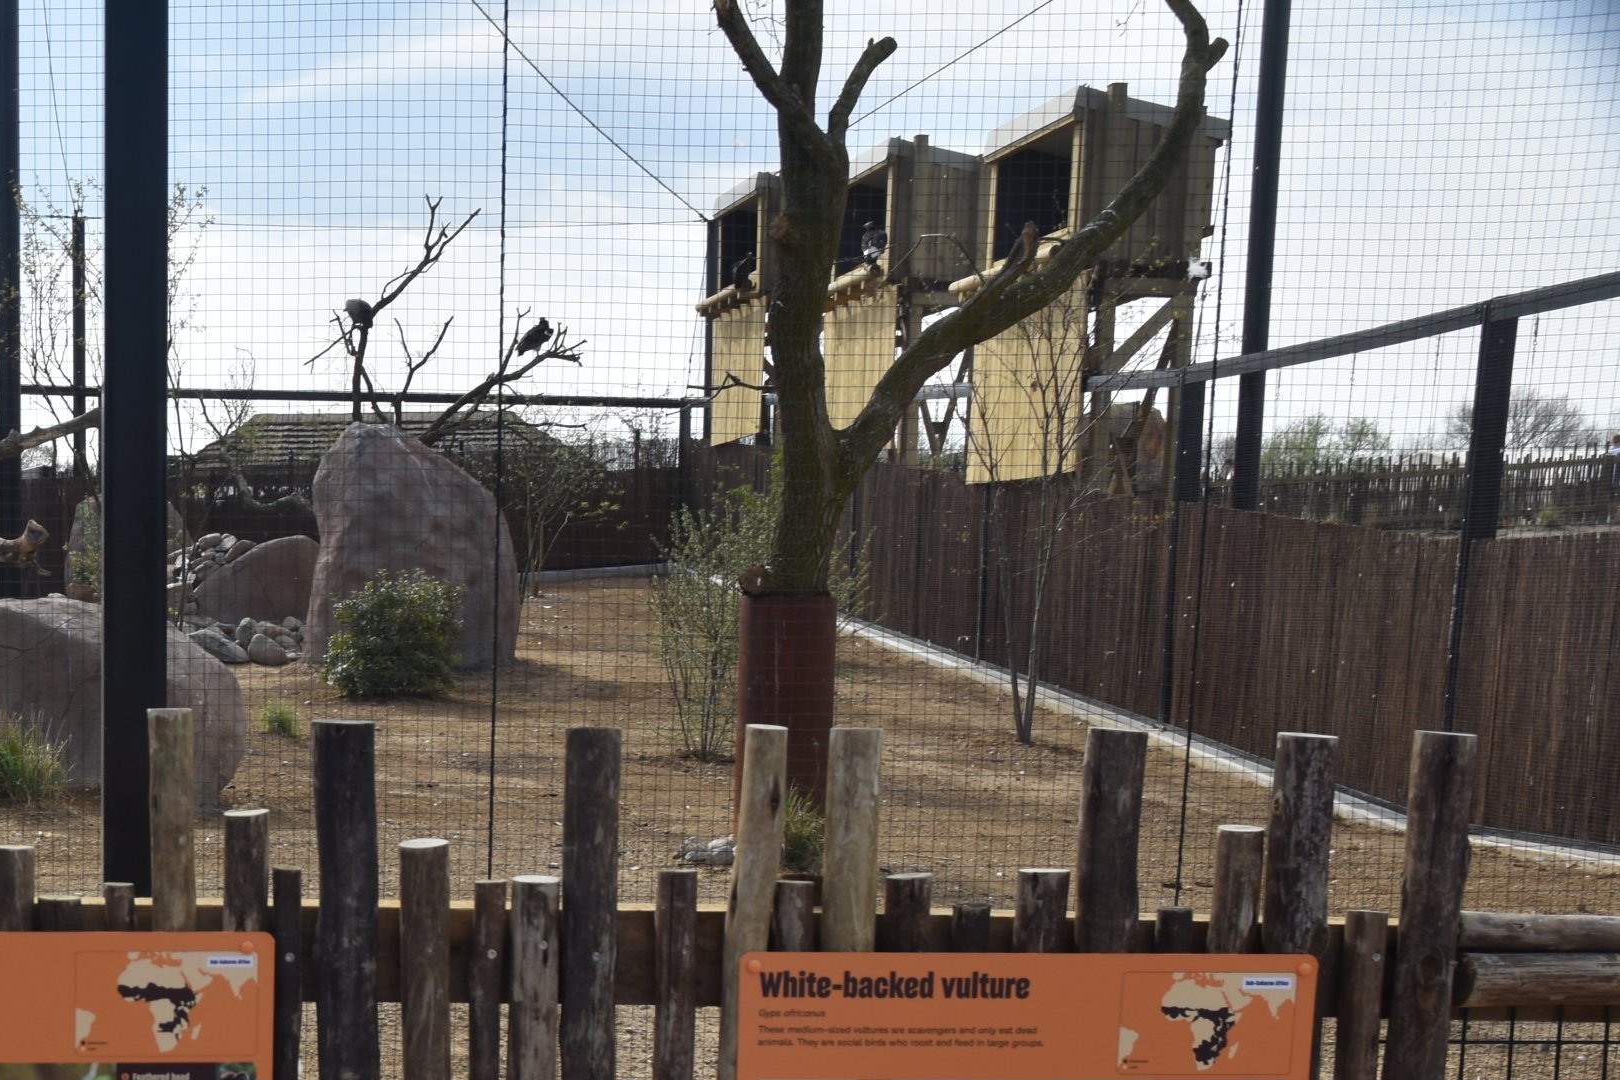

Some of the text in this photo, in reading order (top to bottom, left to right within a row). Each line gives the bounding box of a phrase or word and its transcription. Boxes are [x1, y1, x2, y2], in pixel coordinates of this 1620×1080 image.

[760, 971, 1031, 1000] White-backed vulture
[758, 1025, 785, 1034] These
[786, 1025, 851, 1034] medium-sized
[852, 1025, 888, 1034] vultures
[906, 1027, 956, 1036] scavengers
[958, 1025, 976, 1034] and
[977, 1025, 996, 1036] only
[998, 1025, 1013, 1034] eat
[1014, 1025, 1038, 1034] dead
[797, 1037, 818, 1048] They
[836, 1037, 863, 1046] social
[864, 1037, 886, 1046] birds
[888, 1037, 908, 1046] who
[909, 1037, 933, 1046] roost
[934, 1037, 952, 1046] and
[953, 1037, 974, 1046] feed
[986, 1037, 1009, 1048] large
